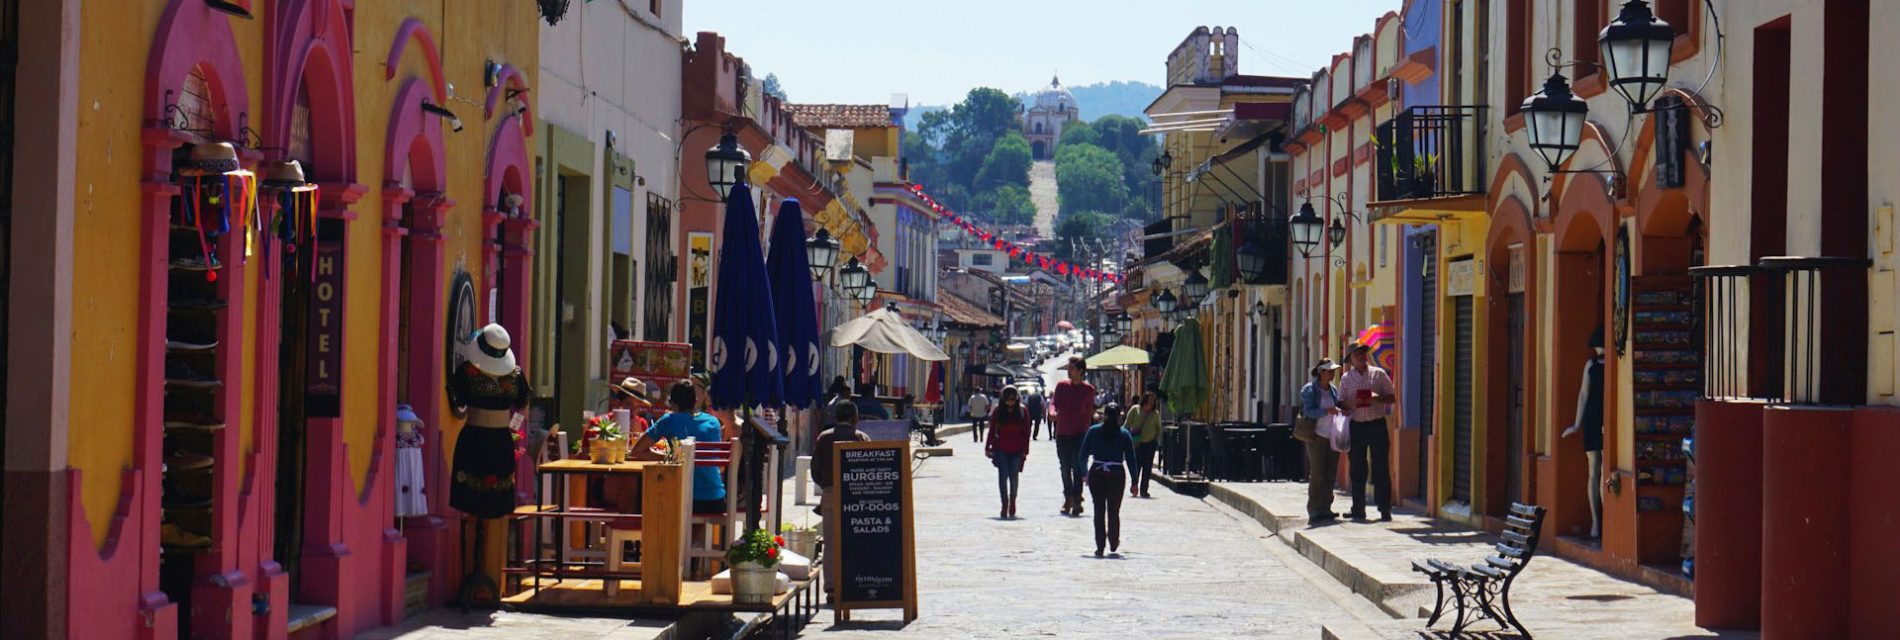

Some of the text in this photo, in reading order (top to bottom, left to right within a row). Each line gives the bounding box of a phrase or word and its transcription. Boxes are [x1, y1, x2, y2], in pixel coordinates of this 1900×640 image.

[318, 256, 333, 379] HOTEL
[843, 472, 899, 482] BURGERS
[844, 503, 899, 512] HOT-DOGS
[852, 516, 892, 526] PASTA &
